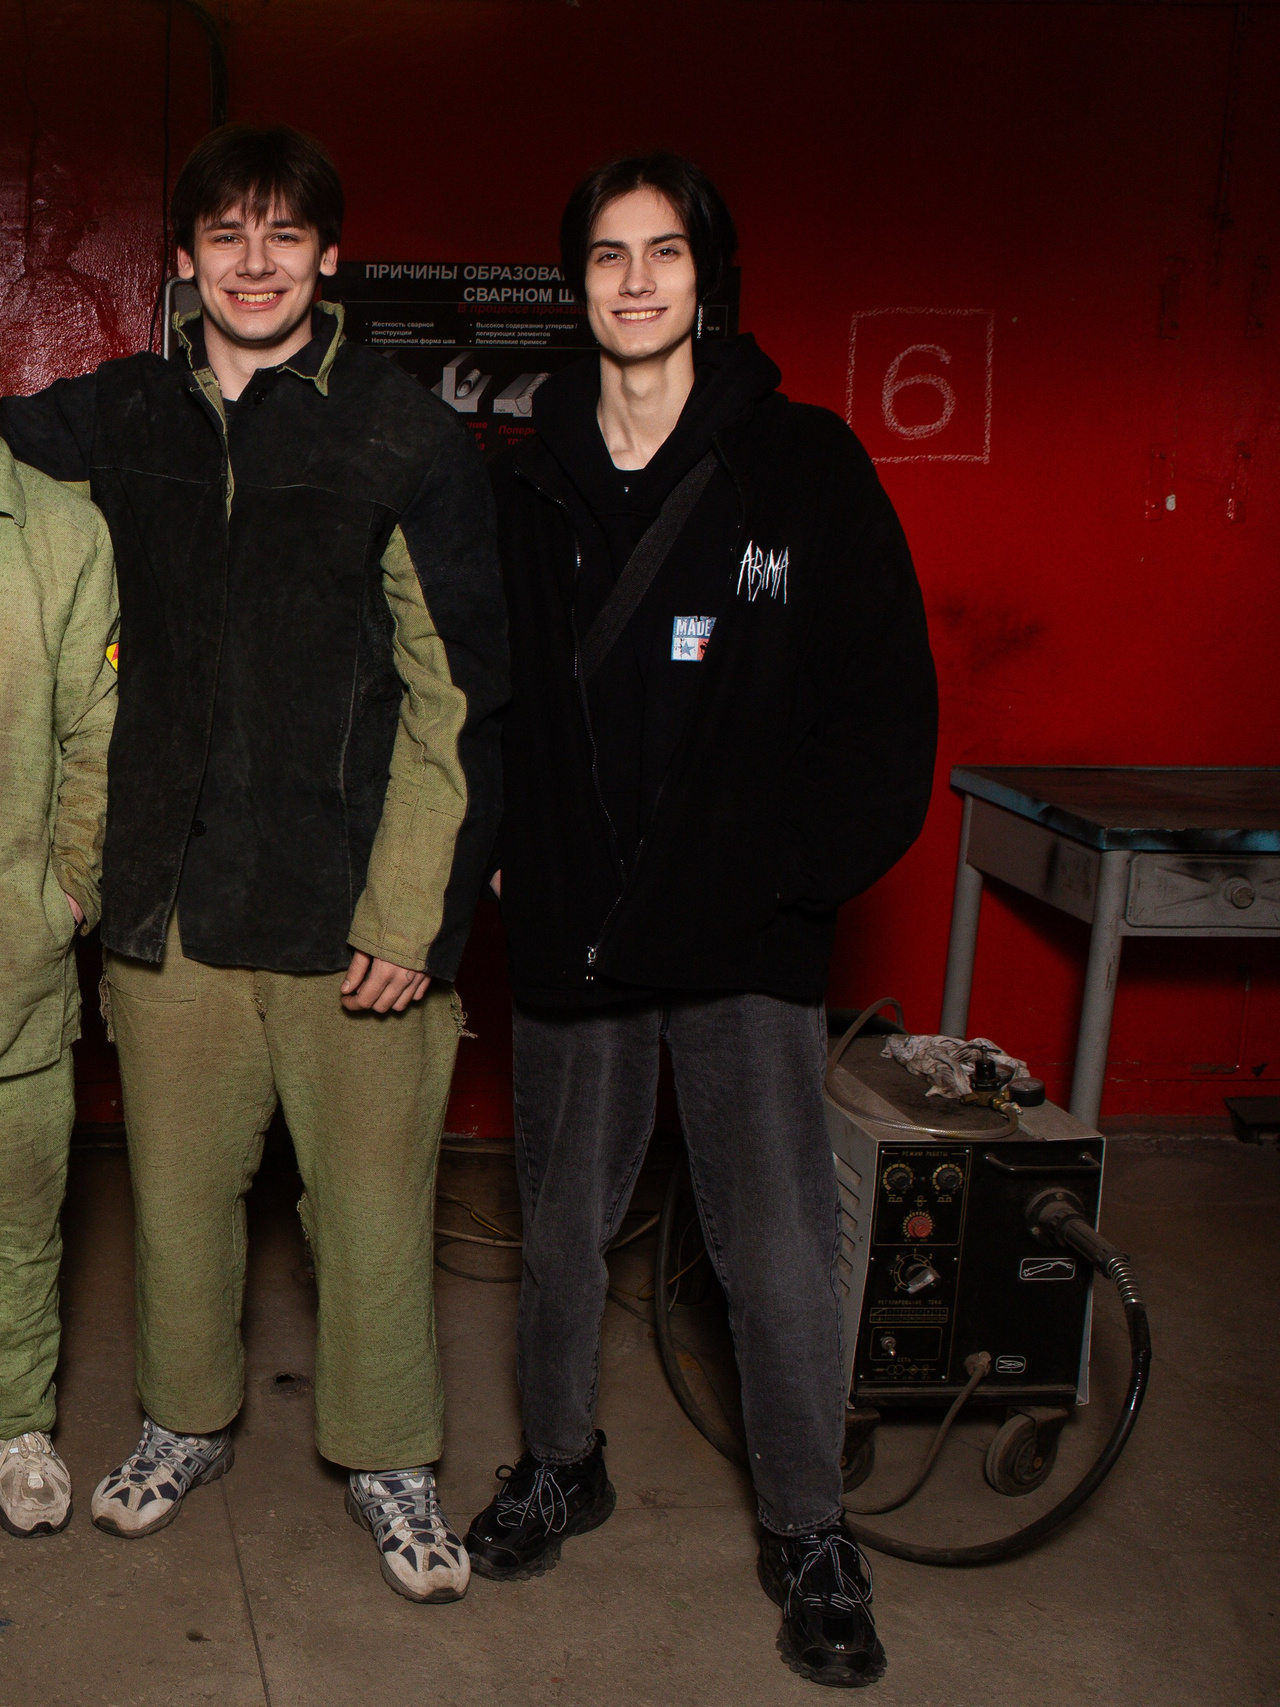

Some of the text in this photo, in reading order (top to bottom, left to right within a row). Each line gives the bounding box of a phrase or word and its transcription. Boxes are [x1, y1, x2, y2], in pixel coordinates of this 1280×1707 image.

[365, 264, 458, 280] ПРИЧИНЫ
[463, 287, 553, 303] СВАРНОМ
[457, 303, 468, 314] В
[469, 304, 529, 317] процессе
[371, 320, 435, 329] Жесткость сварной
[475, 322, 505, 330] Высокое
[505, 322, 544, 330] содержание
[544, 323, 574, 331] углерода
[371, 330, 413, 338] конструкции
[475, 330, 516, 338] легирующих
[371, 337, 419, 345] Неправильная
[419, 338, 441, 346] форма
[474, 338, 548, 347] Легкоплавкие примеси
[881, 343, 957, 442] 6
[675, 618, 712, 637] MADE
[834, 1643, 846, 1651] 44
